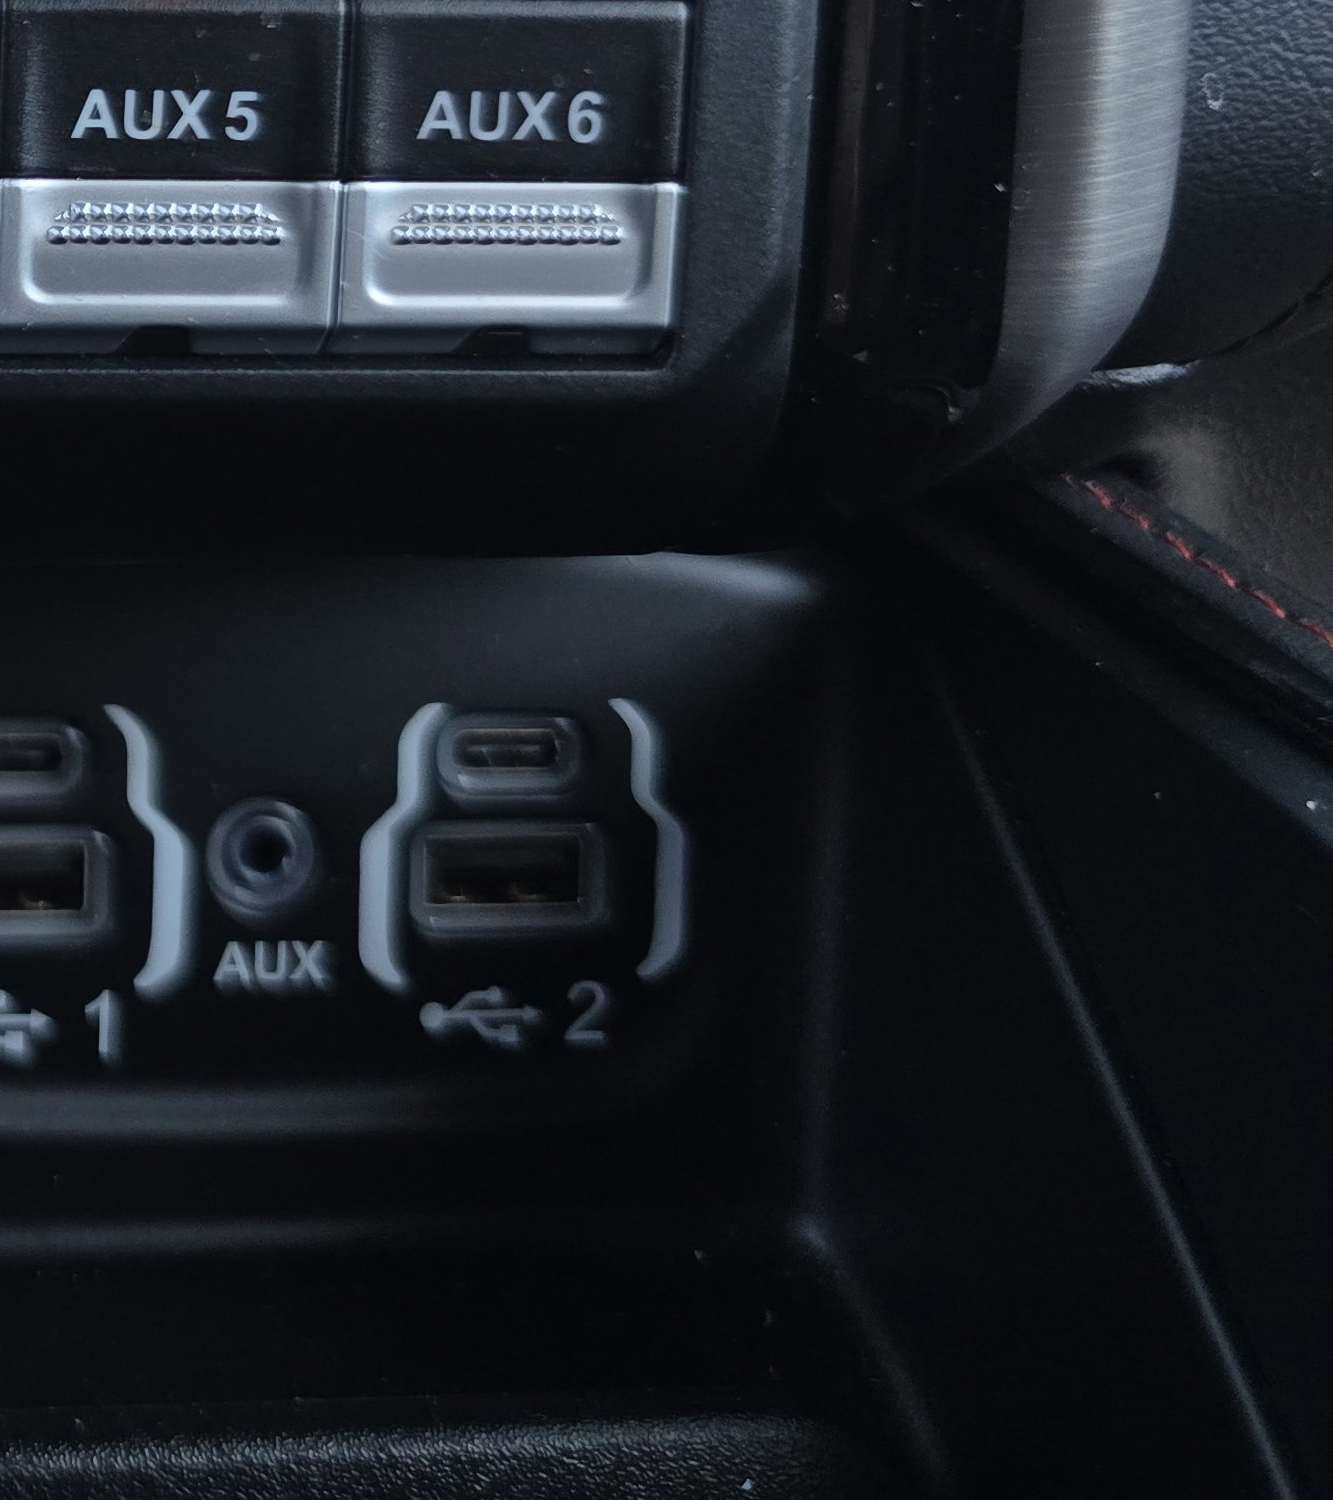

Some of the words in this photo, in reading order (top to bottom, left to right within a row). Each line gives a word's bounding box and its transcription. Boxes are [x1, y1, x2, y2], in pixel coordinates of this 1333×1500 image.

[71, 89, 210, 139] AUX
[226, 92, 258, 140] 5
[417, 91, 555, 140] AUX
[569, 91, 602, 143] 6
[214, 941, 325, 985] AUX
[84, 989, 118, 1058] 1
[567, 983, 607, 1042] 2
